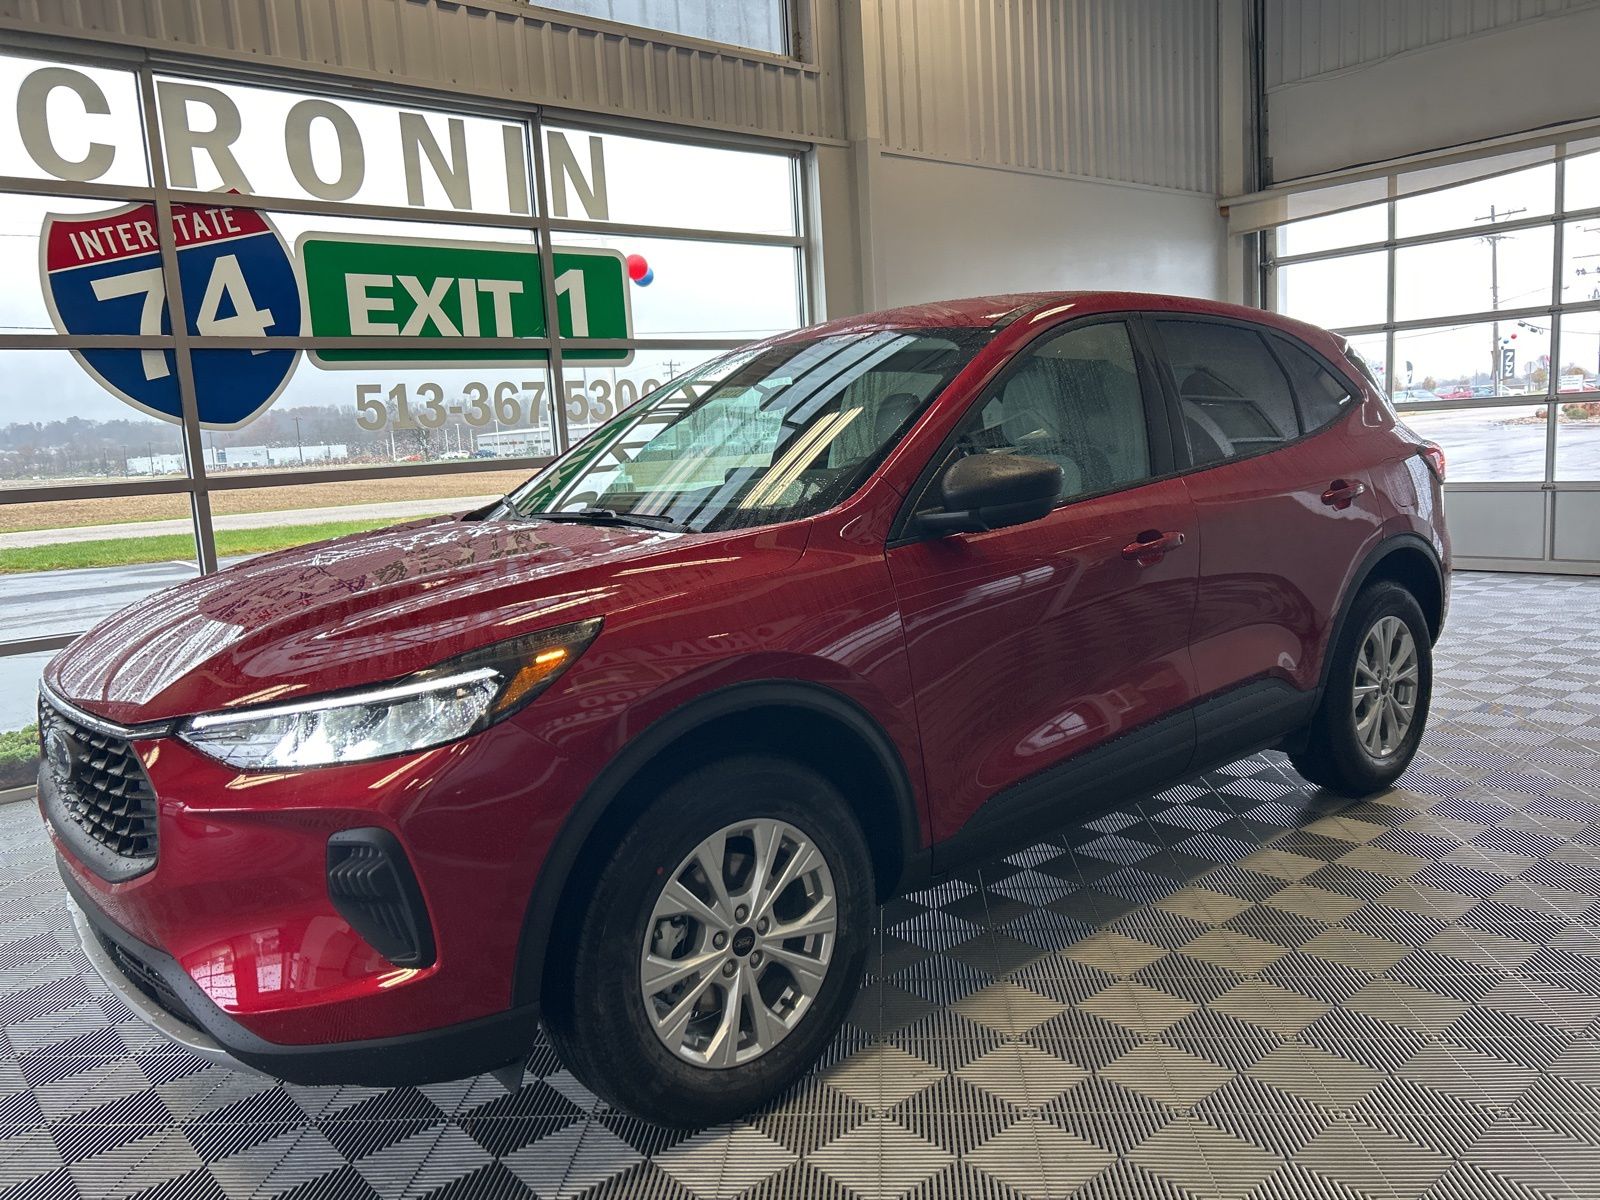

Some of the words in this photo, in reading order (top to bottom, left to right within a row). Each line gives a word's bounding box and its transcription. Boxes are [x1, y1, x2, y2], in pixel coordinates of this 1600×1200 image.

[16, 66, 608, 220] CRONIN
[69, 207, 241, 260] INTERTATE
[90, 253, 275, 381] 74
[345, 273, 524, 338] EXIT
[554, 269, 589, 338] 1
